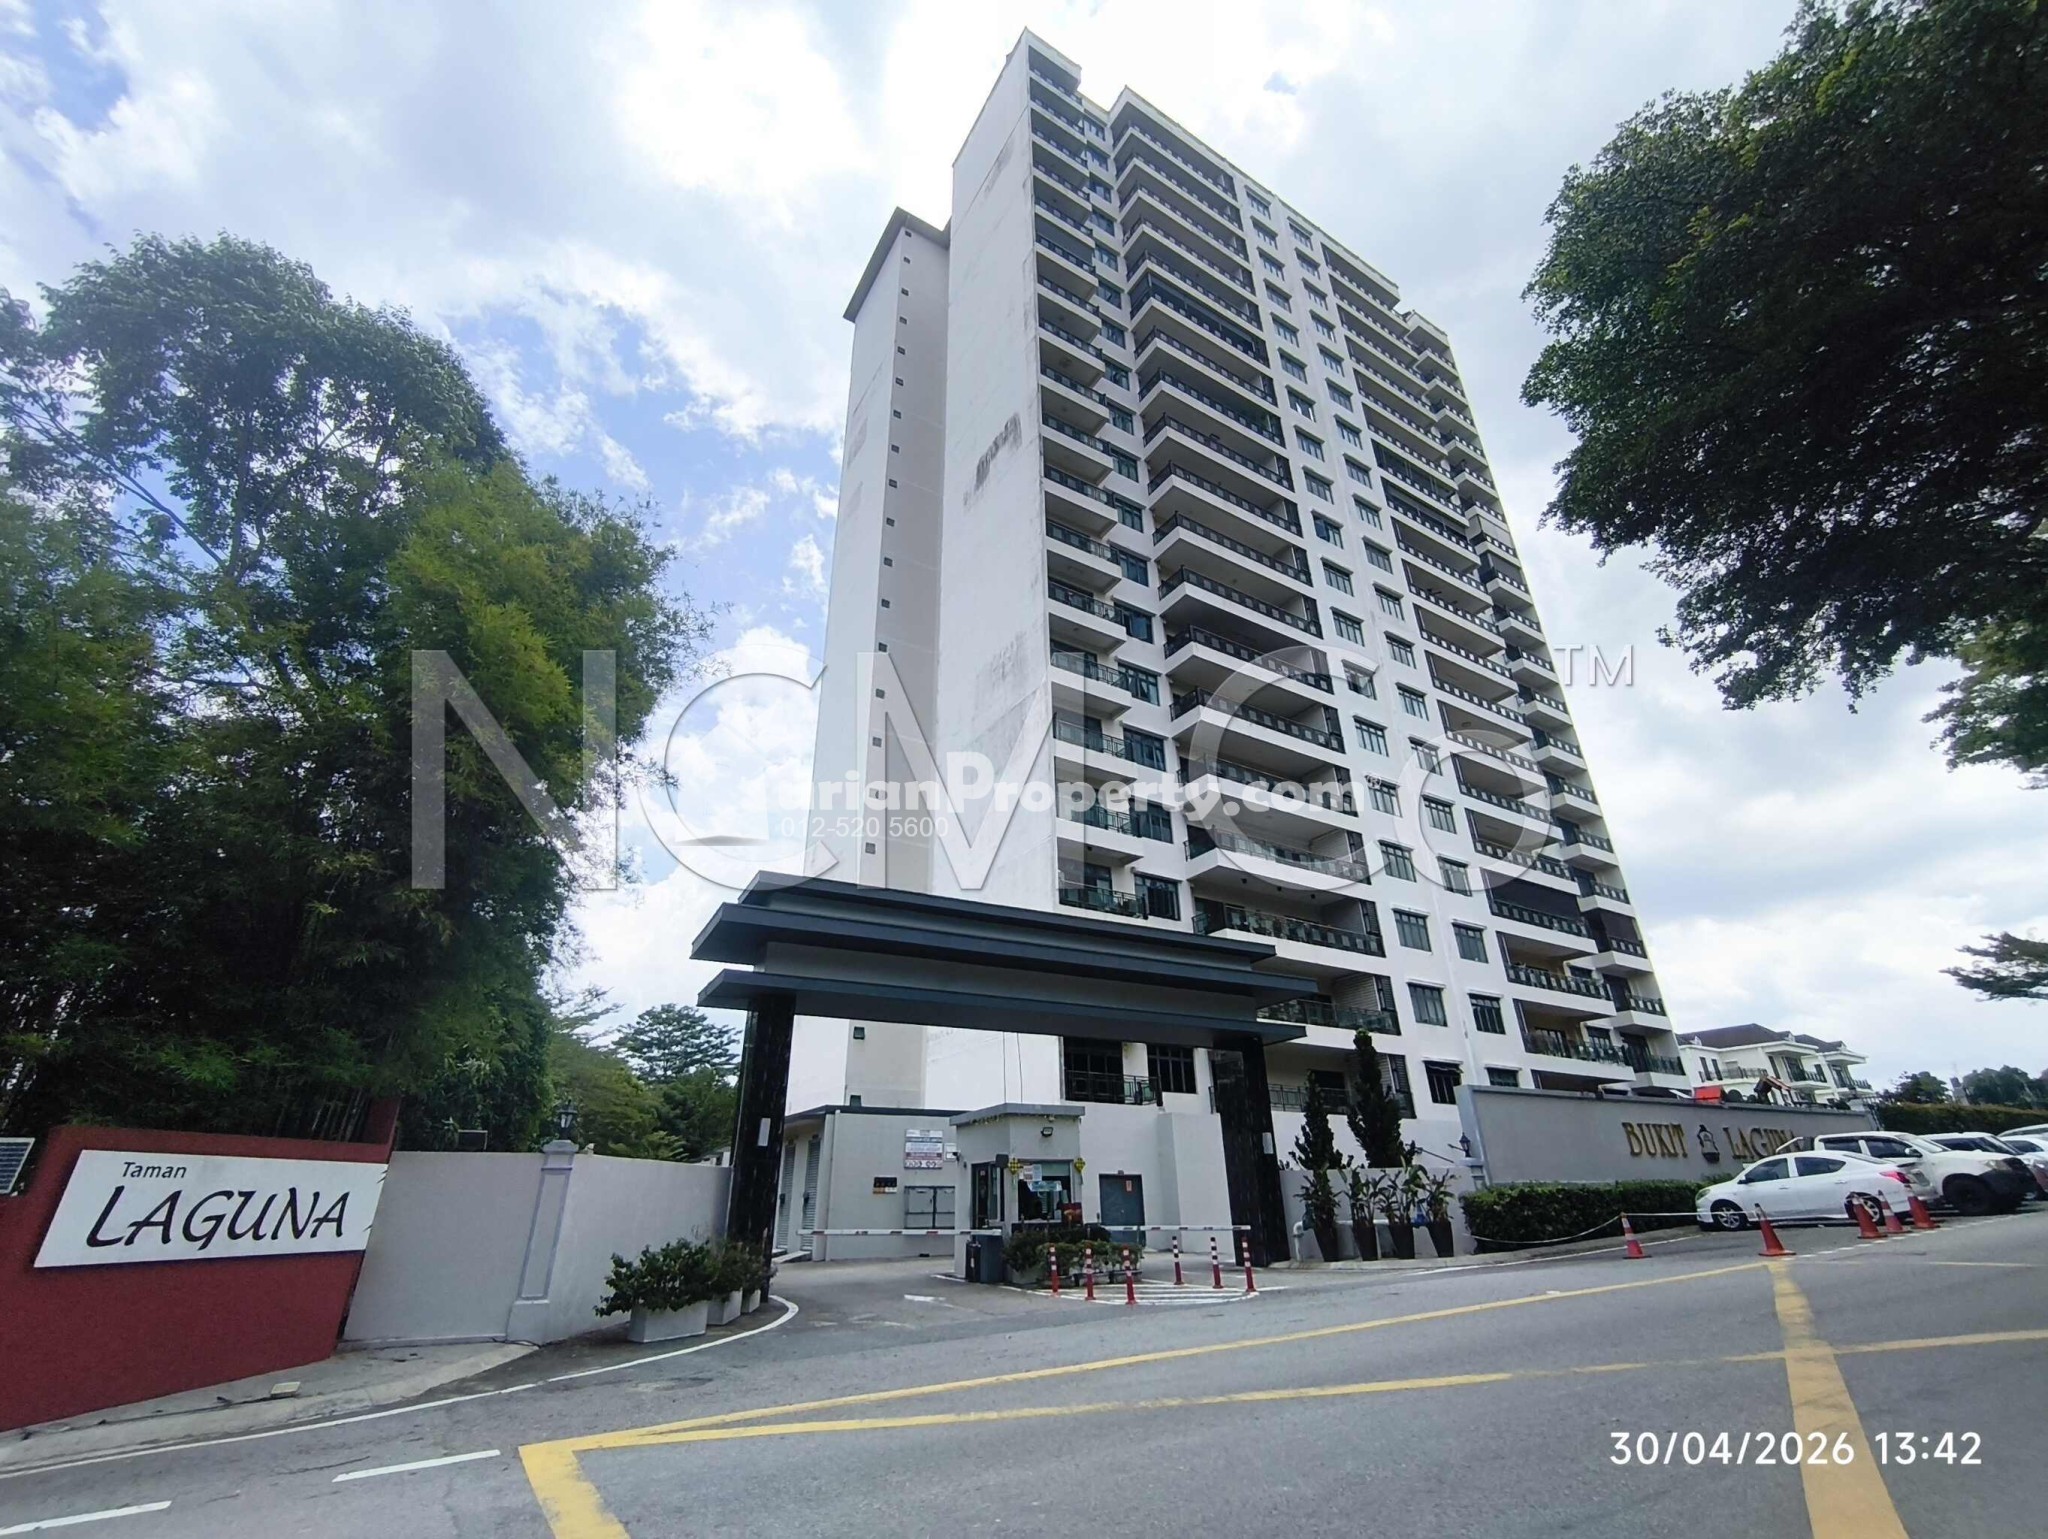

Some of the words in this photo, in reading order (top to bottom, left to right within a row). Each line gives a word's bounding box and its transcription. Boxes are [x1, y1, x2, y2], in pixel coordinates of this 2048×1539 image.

[1621, 1122, 1688, 1158] BUKIT
[121, 1161, 188, 1179] Taman
[86, 1184, 351, 1251] LAGUNA
